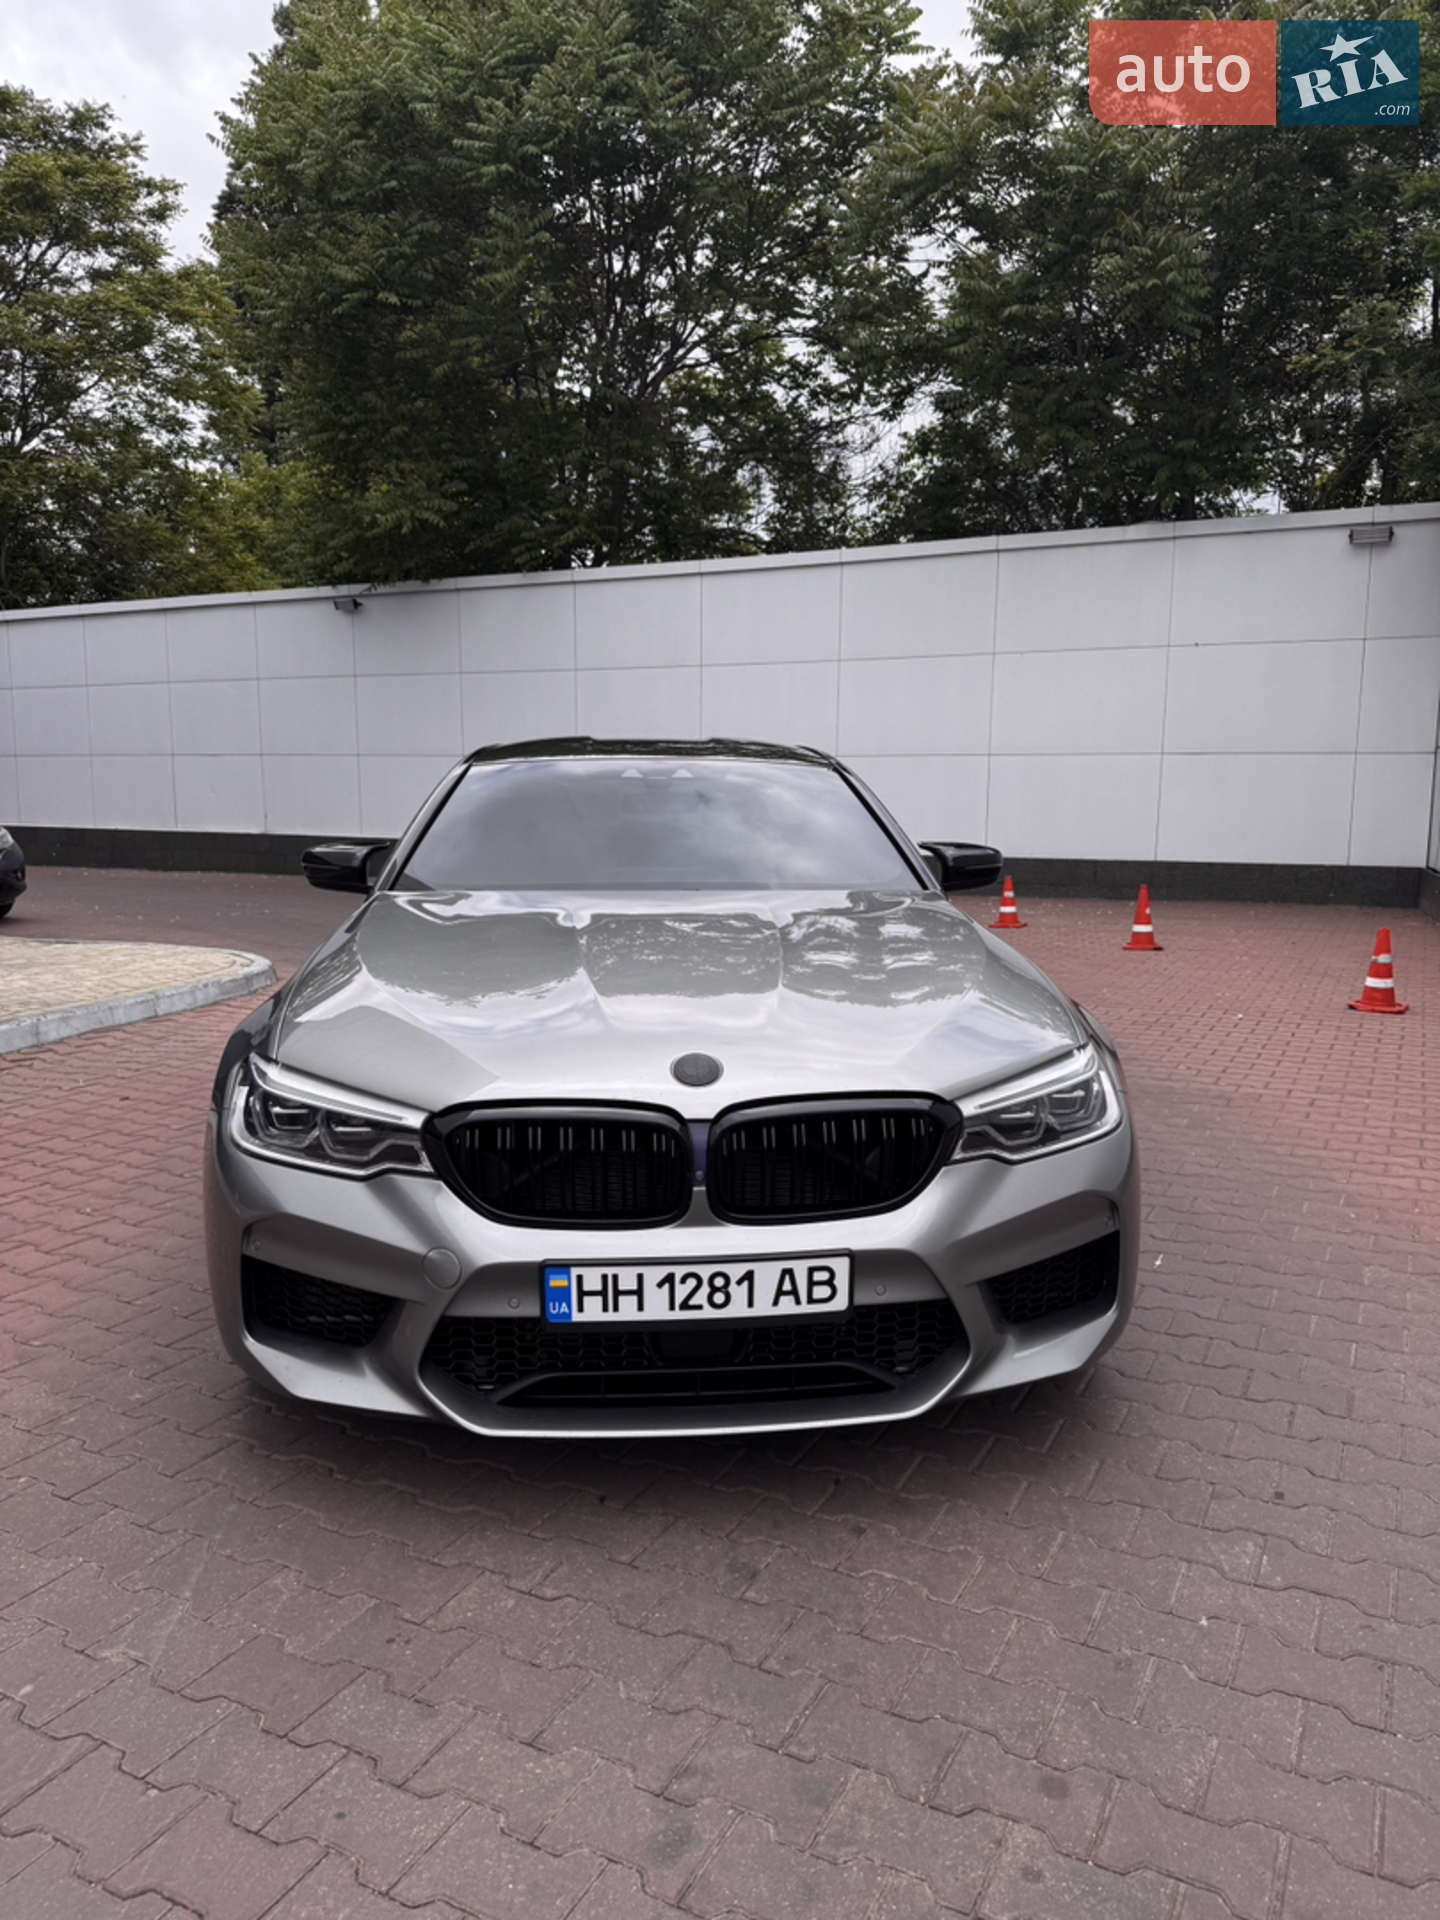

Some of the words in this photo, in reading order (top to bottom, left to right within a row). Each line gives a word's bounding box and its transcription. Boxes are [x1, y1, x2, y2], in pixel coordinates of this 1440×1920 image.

[576, 1272, 644, 1313] HH
[655, 1269, 755, 1311] 1281
[771, 1265, 838, 1307] AB
[550, 1302, 569, 1314] UA
